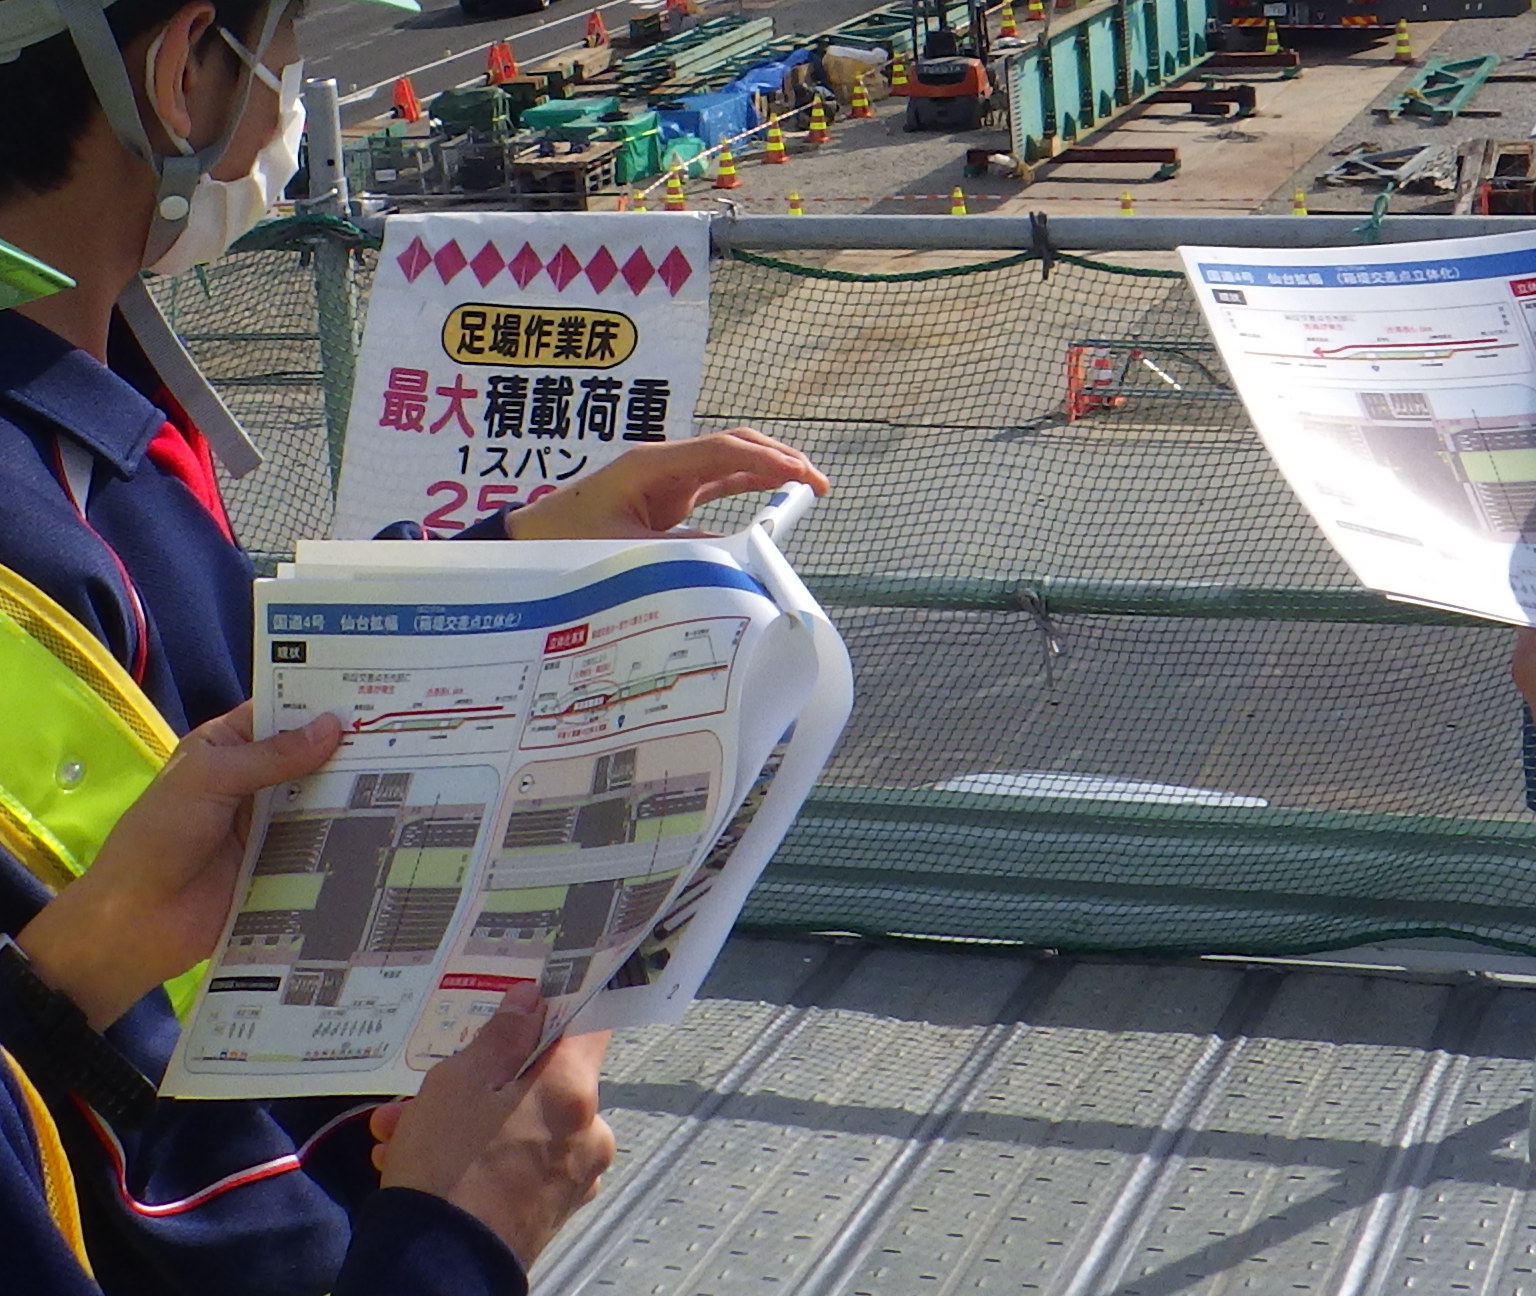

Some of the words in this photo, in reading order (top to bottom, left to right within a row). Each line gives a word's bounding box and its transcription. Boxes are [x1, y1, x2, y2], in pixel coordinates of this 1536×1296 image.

[924, 65, 961, 75] TOYOTA
[456, 310, 622, 361] 足場作業床
[378, 366, 672, 442] 最大積載荷重
[458, 445, 589, 480] 1スパン
[423, 480, 559, 531] 25
